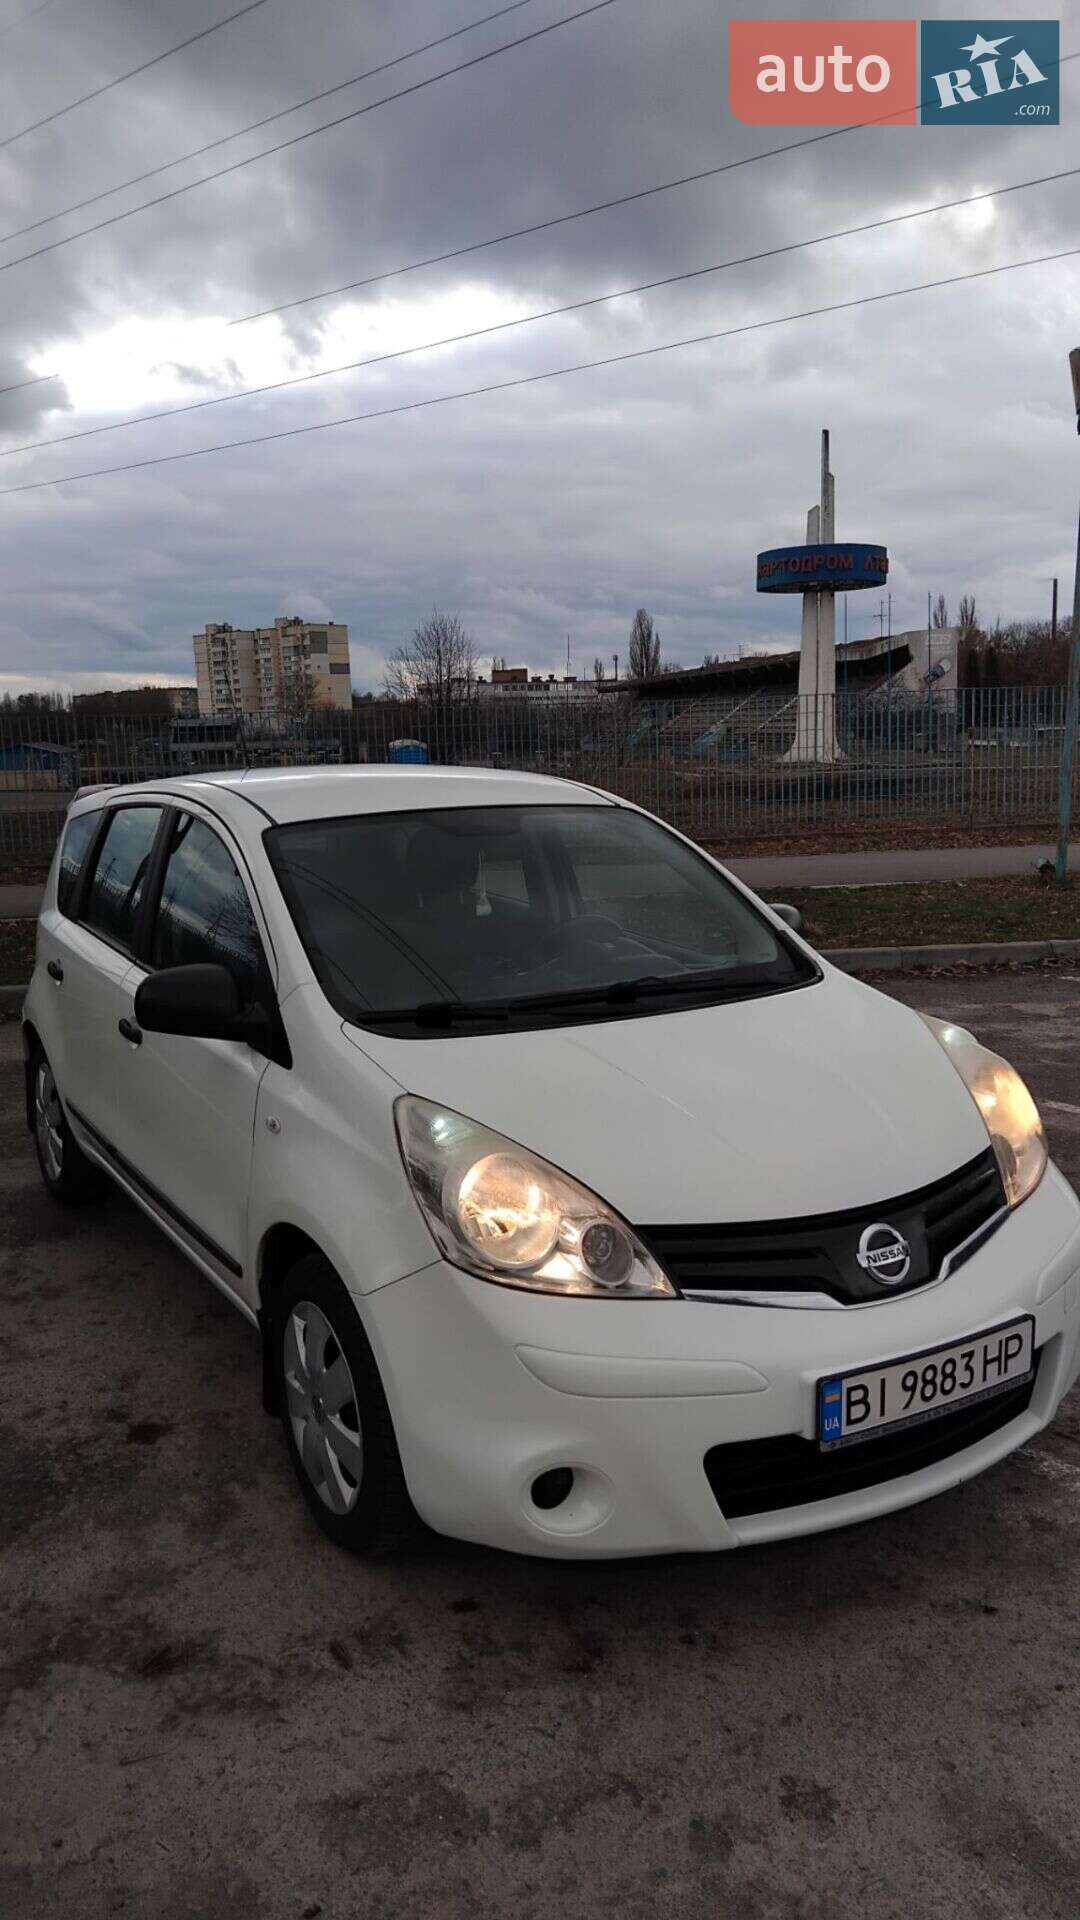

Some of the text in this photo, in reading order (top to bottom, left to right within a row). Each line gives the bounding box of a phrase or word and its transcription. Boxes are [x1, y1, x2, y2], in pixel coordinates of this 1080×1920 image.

[845, 1377, 886, 1426] BI
[901, 1350, 976, 1410] 9883
[982, 1333, 1023, 1382] HP
[824, 1418, 841, 1431] UA
